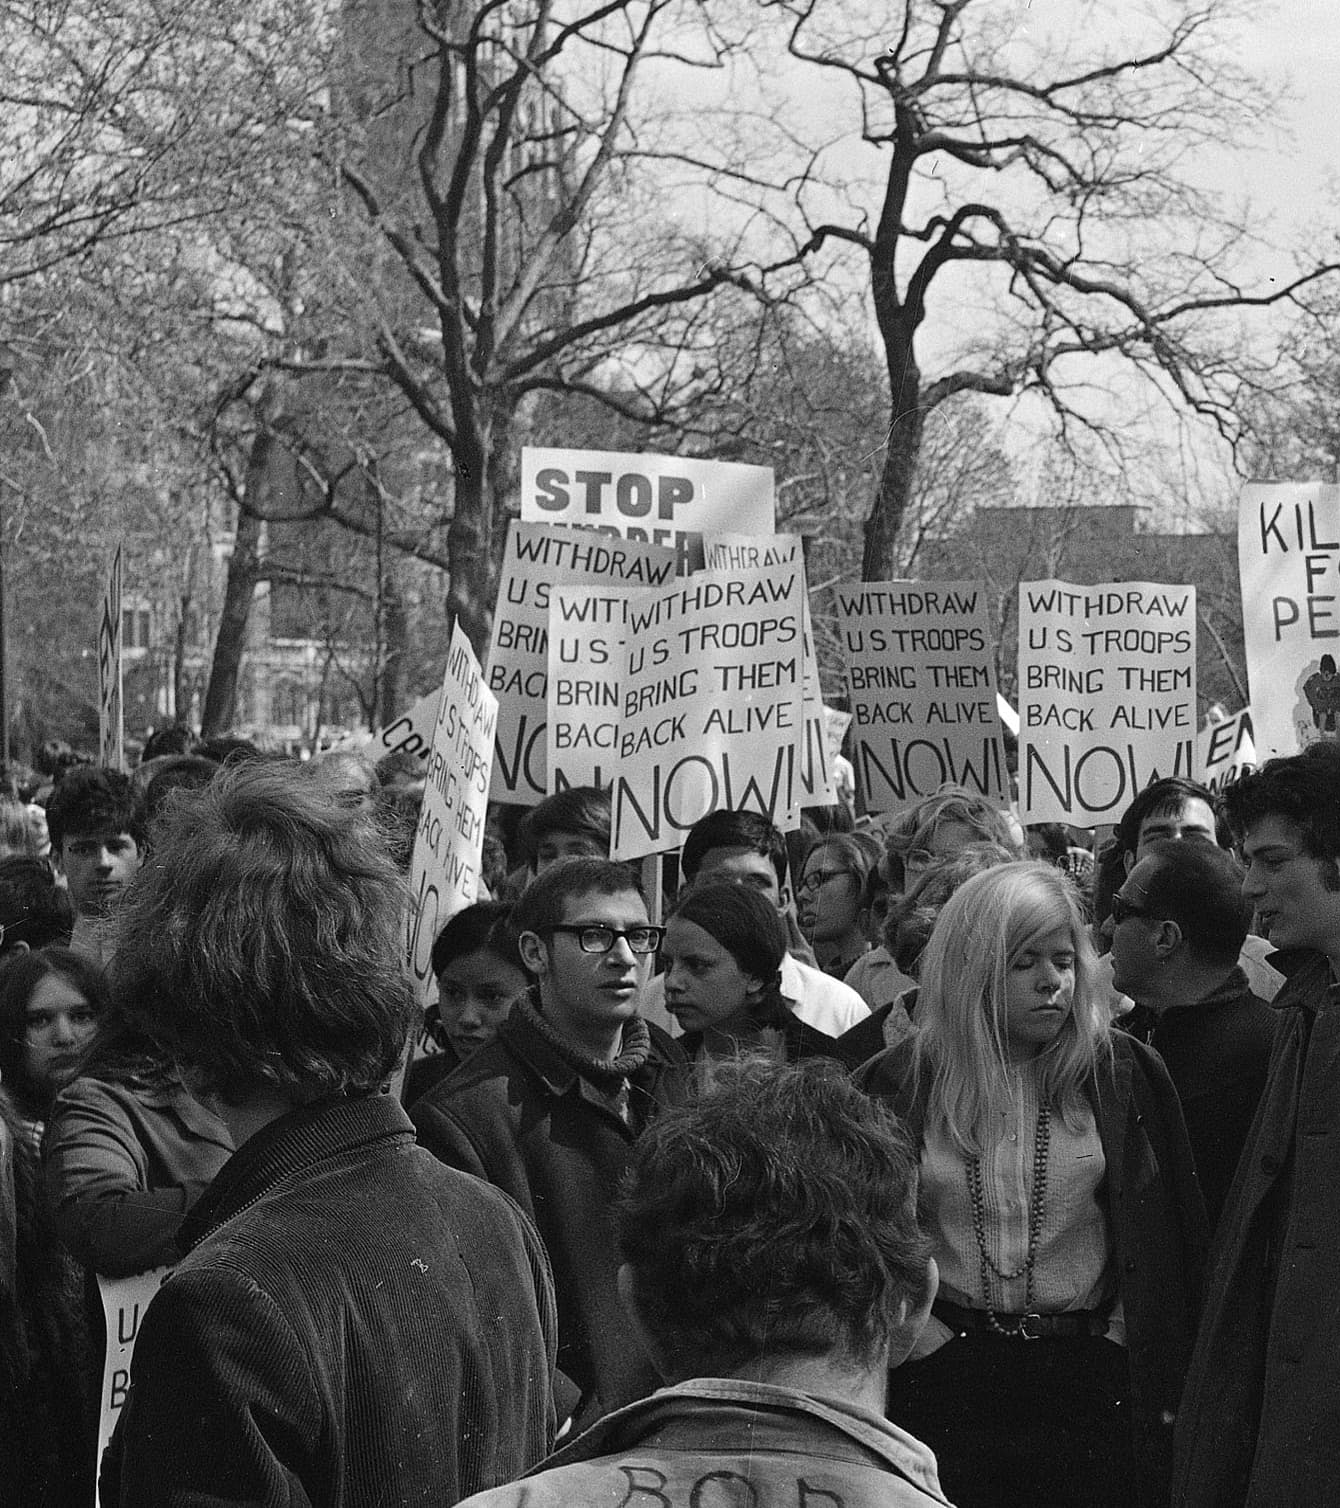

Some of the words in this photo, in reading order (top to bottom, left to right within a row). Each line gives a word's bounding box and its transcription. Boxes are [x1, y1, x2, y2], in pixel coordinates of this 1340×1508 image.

[535, 468, 694, 520] STOP
[516, 532, 672, 585] WITHDRAW
[631, 574, 796, 635] WITHDRAW
[839, 591, 978, 617] WITHDRAW
[1027, 589, 1189, 619] WITHDRAW
[679, 616, 796, 654] TROOPS
[892, 628, 985, 652] TROOPS
[1082, 629, 1192, 655] TROOPS
[625, 669, 699, 718] BRING
[713, 658, 796, 691] THEM
[851, 665, 917, 690] BRING
[926, 665, 990, 688] THEM
[1026, 664, 1104, 694] BRING
[1118, 666, 1191, 692] THEM
[855, 701, 914, 725] BACK
[926, 701, 993, 724] ALIVE
[1027, 703, 1094, 732] BACK
[1110, 703, 1190, 731] ALIVE
[621, 714, 687, 759] BACK
[703, 702, 793, 735] ALIVE
[860, 737, 1005, 801] NOW!
[615, 744, 795, 850] NOW!
